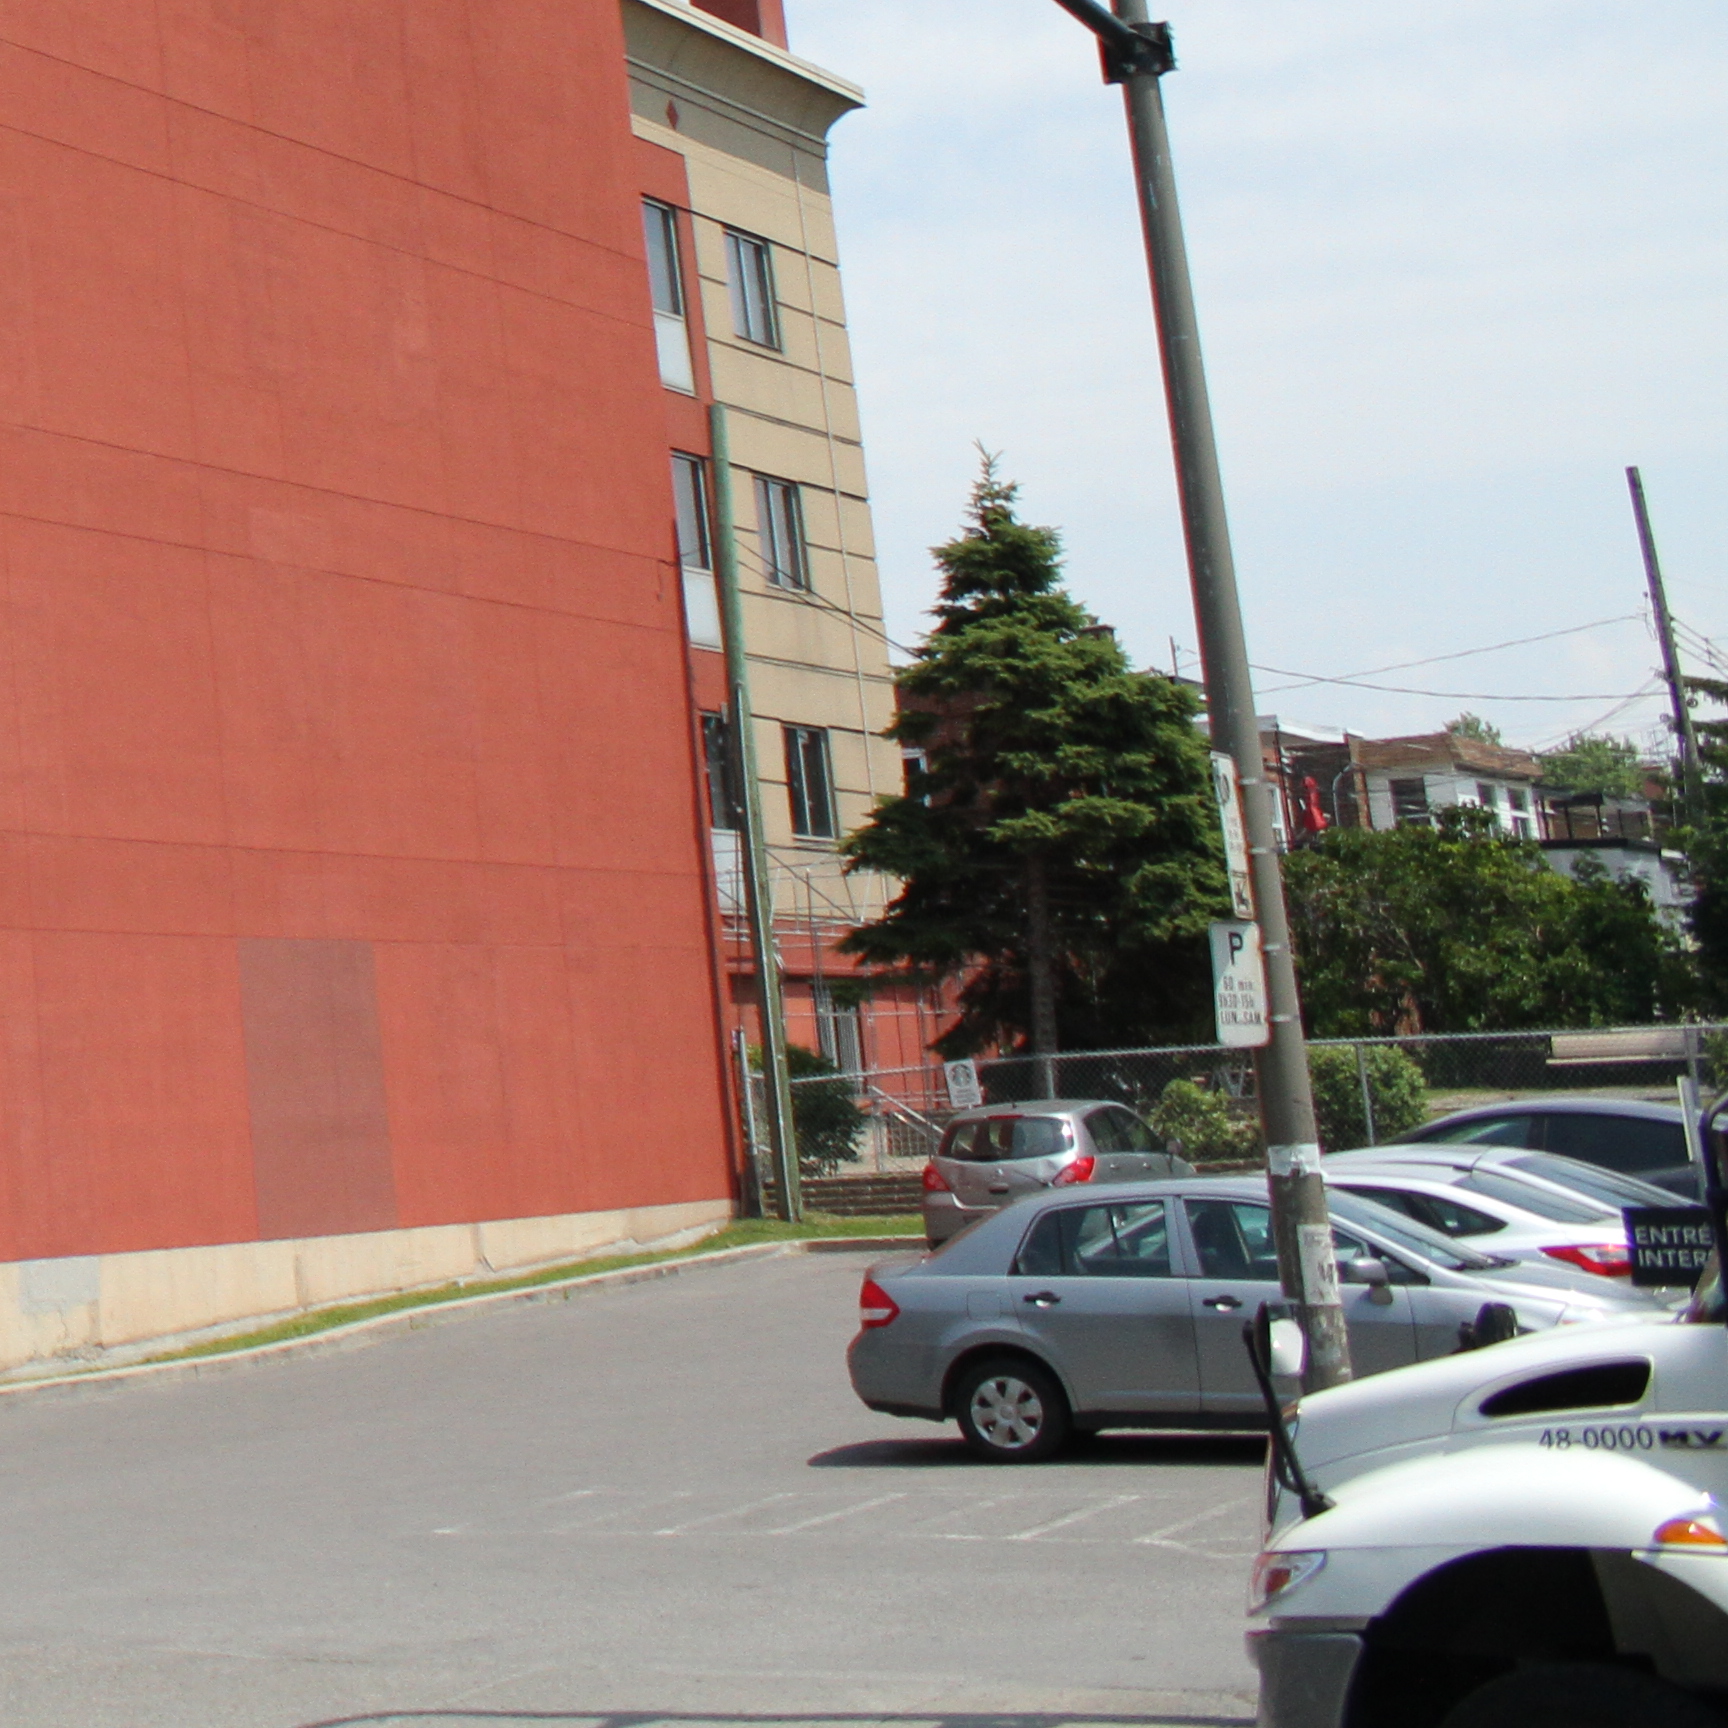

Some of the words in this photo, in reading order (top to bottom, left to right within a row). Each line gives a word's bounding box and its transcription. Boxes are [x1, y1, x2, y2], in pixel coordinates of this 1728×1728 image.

[1228, 931, 1243, 965] P
[1634, 1221, 1713, 1245] ENTRÉ
[1638, 1248, 1708, 1268] INTER
[1539, 1425, 1654, 1450] 48-0000
